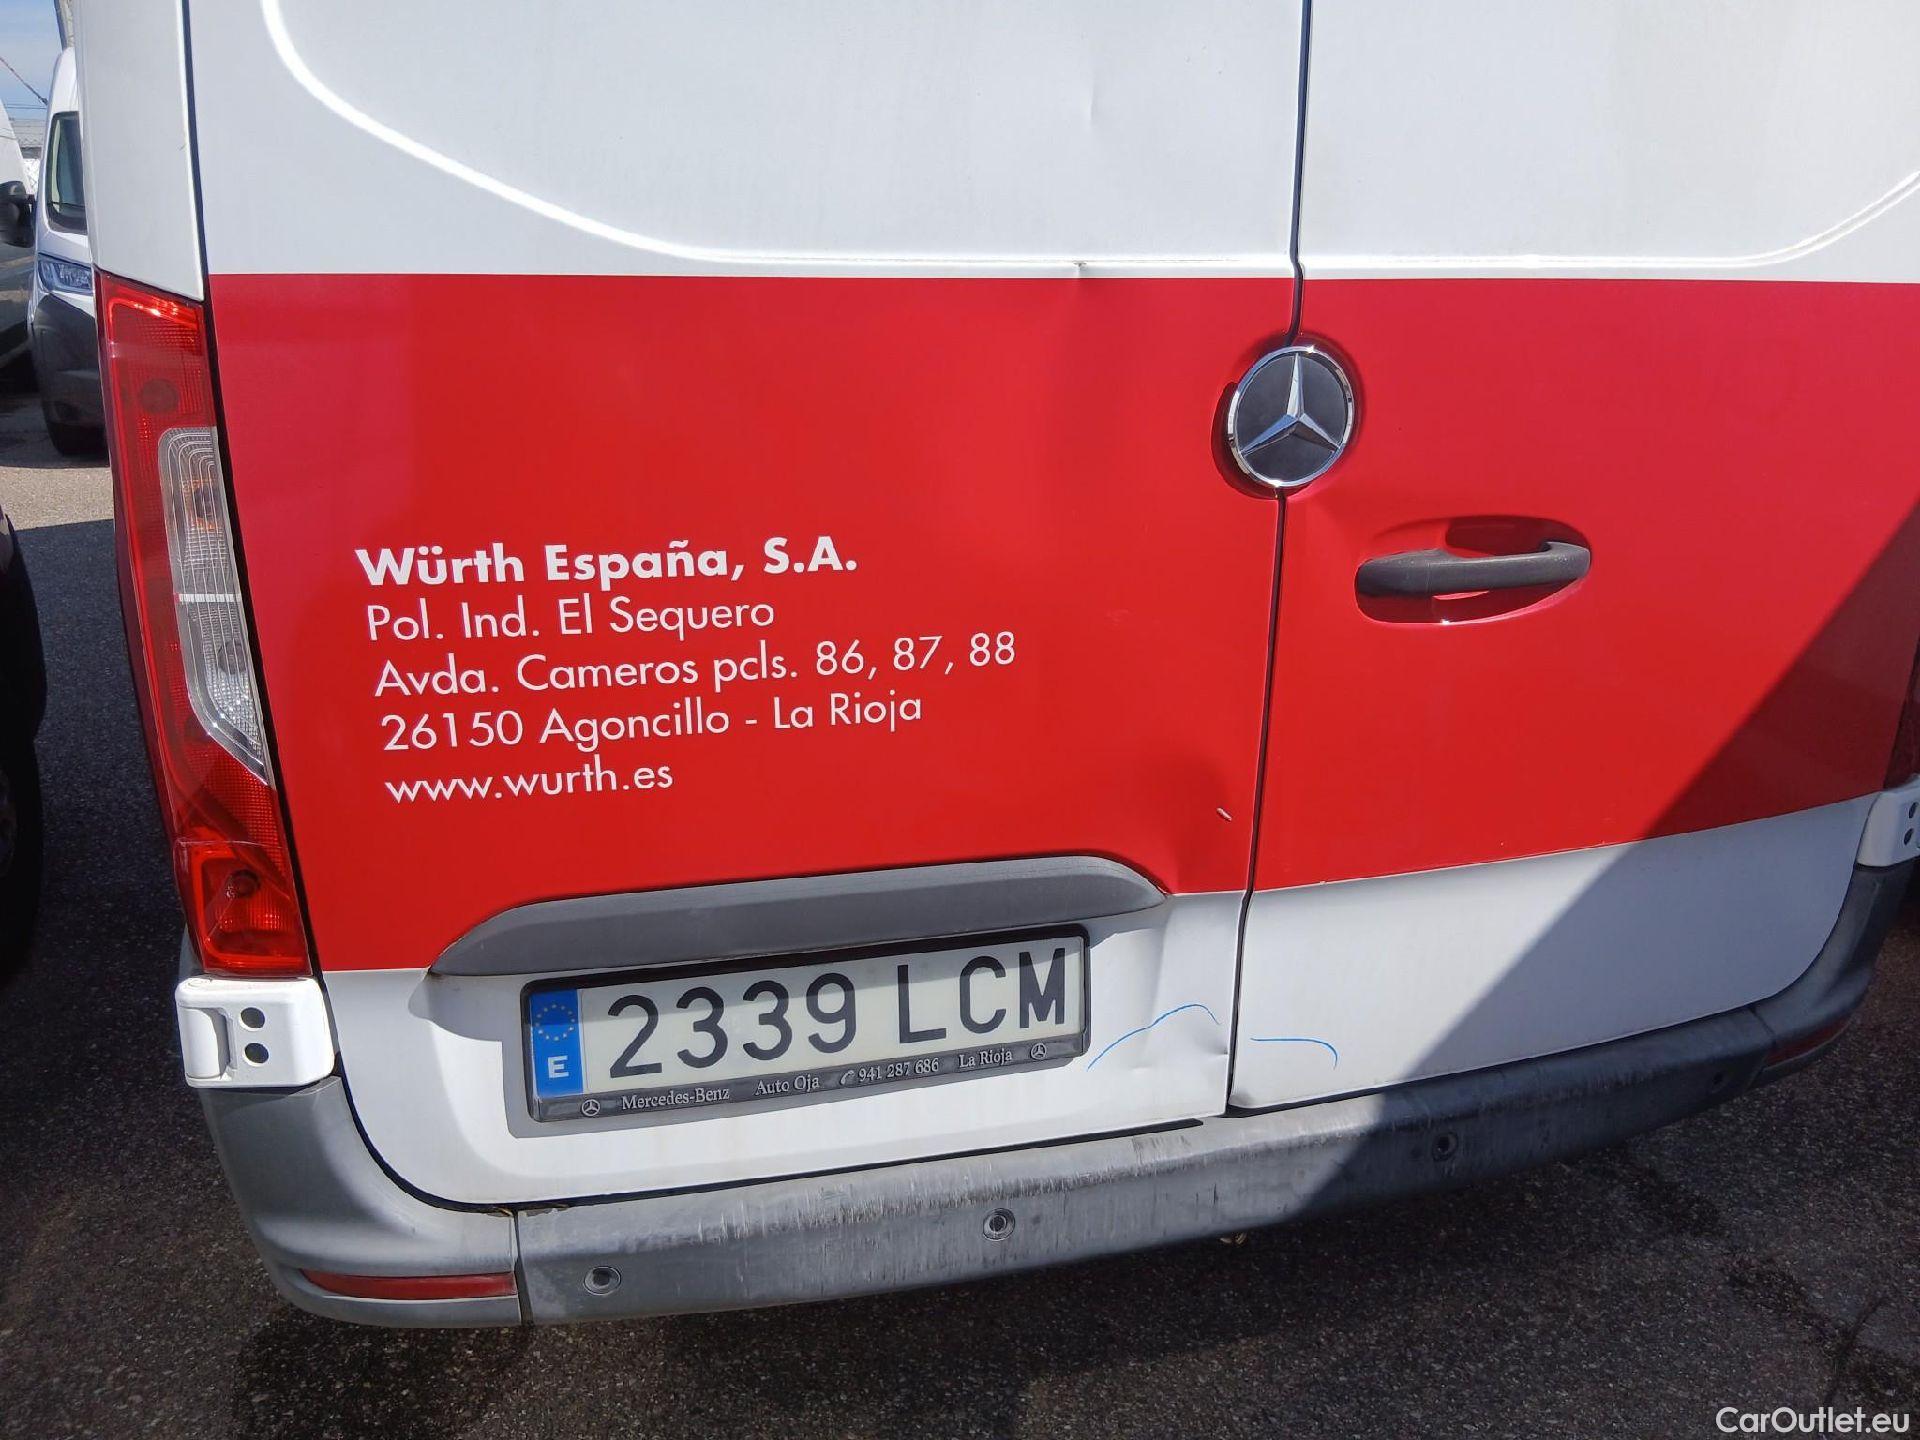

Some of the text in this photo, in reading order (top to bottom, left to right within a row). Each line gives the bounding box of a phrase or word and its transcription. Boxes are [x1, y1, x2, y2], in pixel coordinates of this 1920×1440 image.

[355, 536, 856, 591] Würth España, S.A.
[368, 593, 773, 641] Pol. Ind. El Sequero
[375, 631, 1014, 696] Avda. Cameros pcls. 86, 87, 88
[382, 690, 920, 752] 26150 Agoncillo - La Rioja
[385, 754, 672, 803] www.wurth.es
[606, 947, 1067, 1079] 2339 LCM
[547, 1055, 570, 1078] E
[621, 1047, 1014, 1111] Mercedes-Benz Auto Oja 941 287 686 La Rioja
